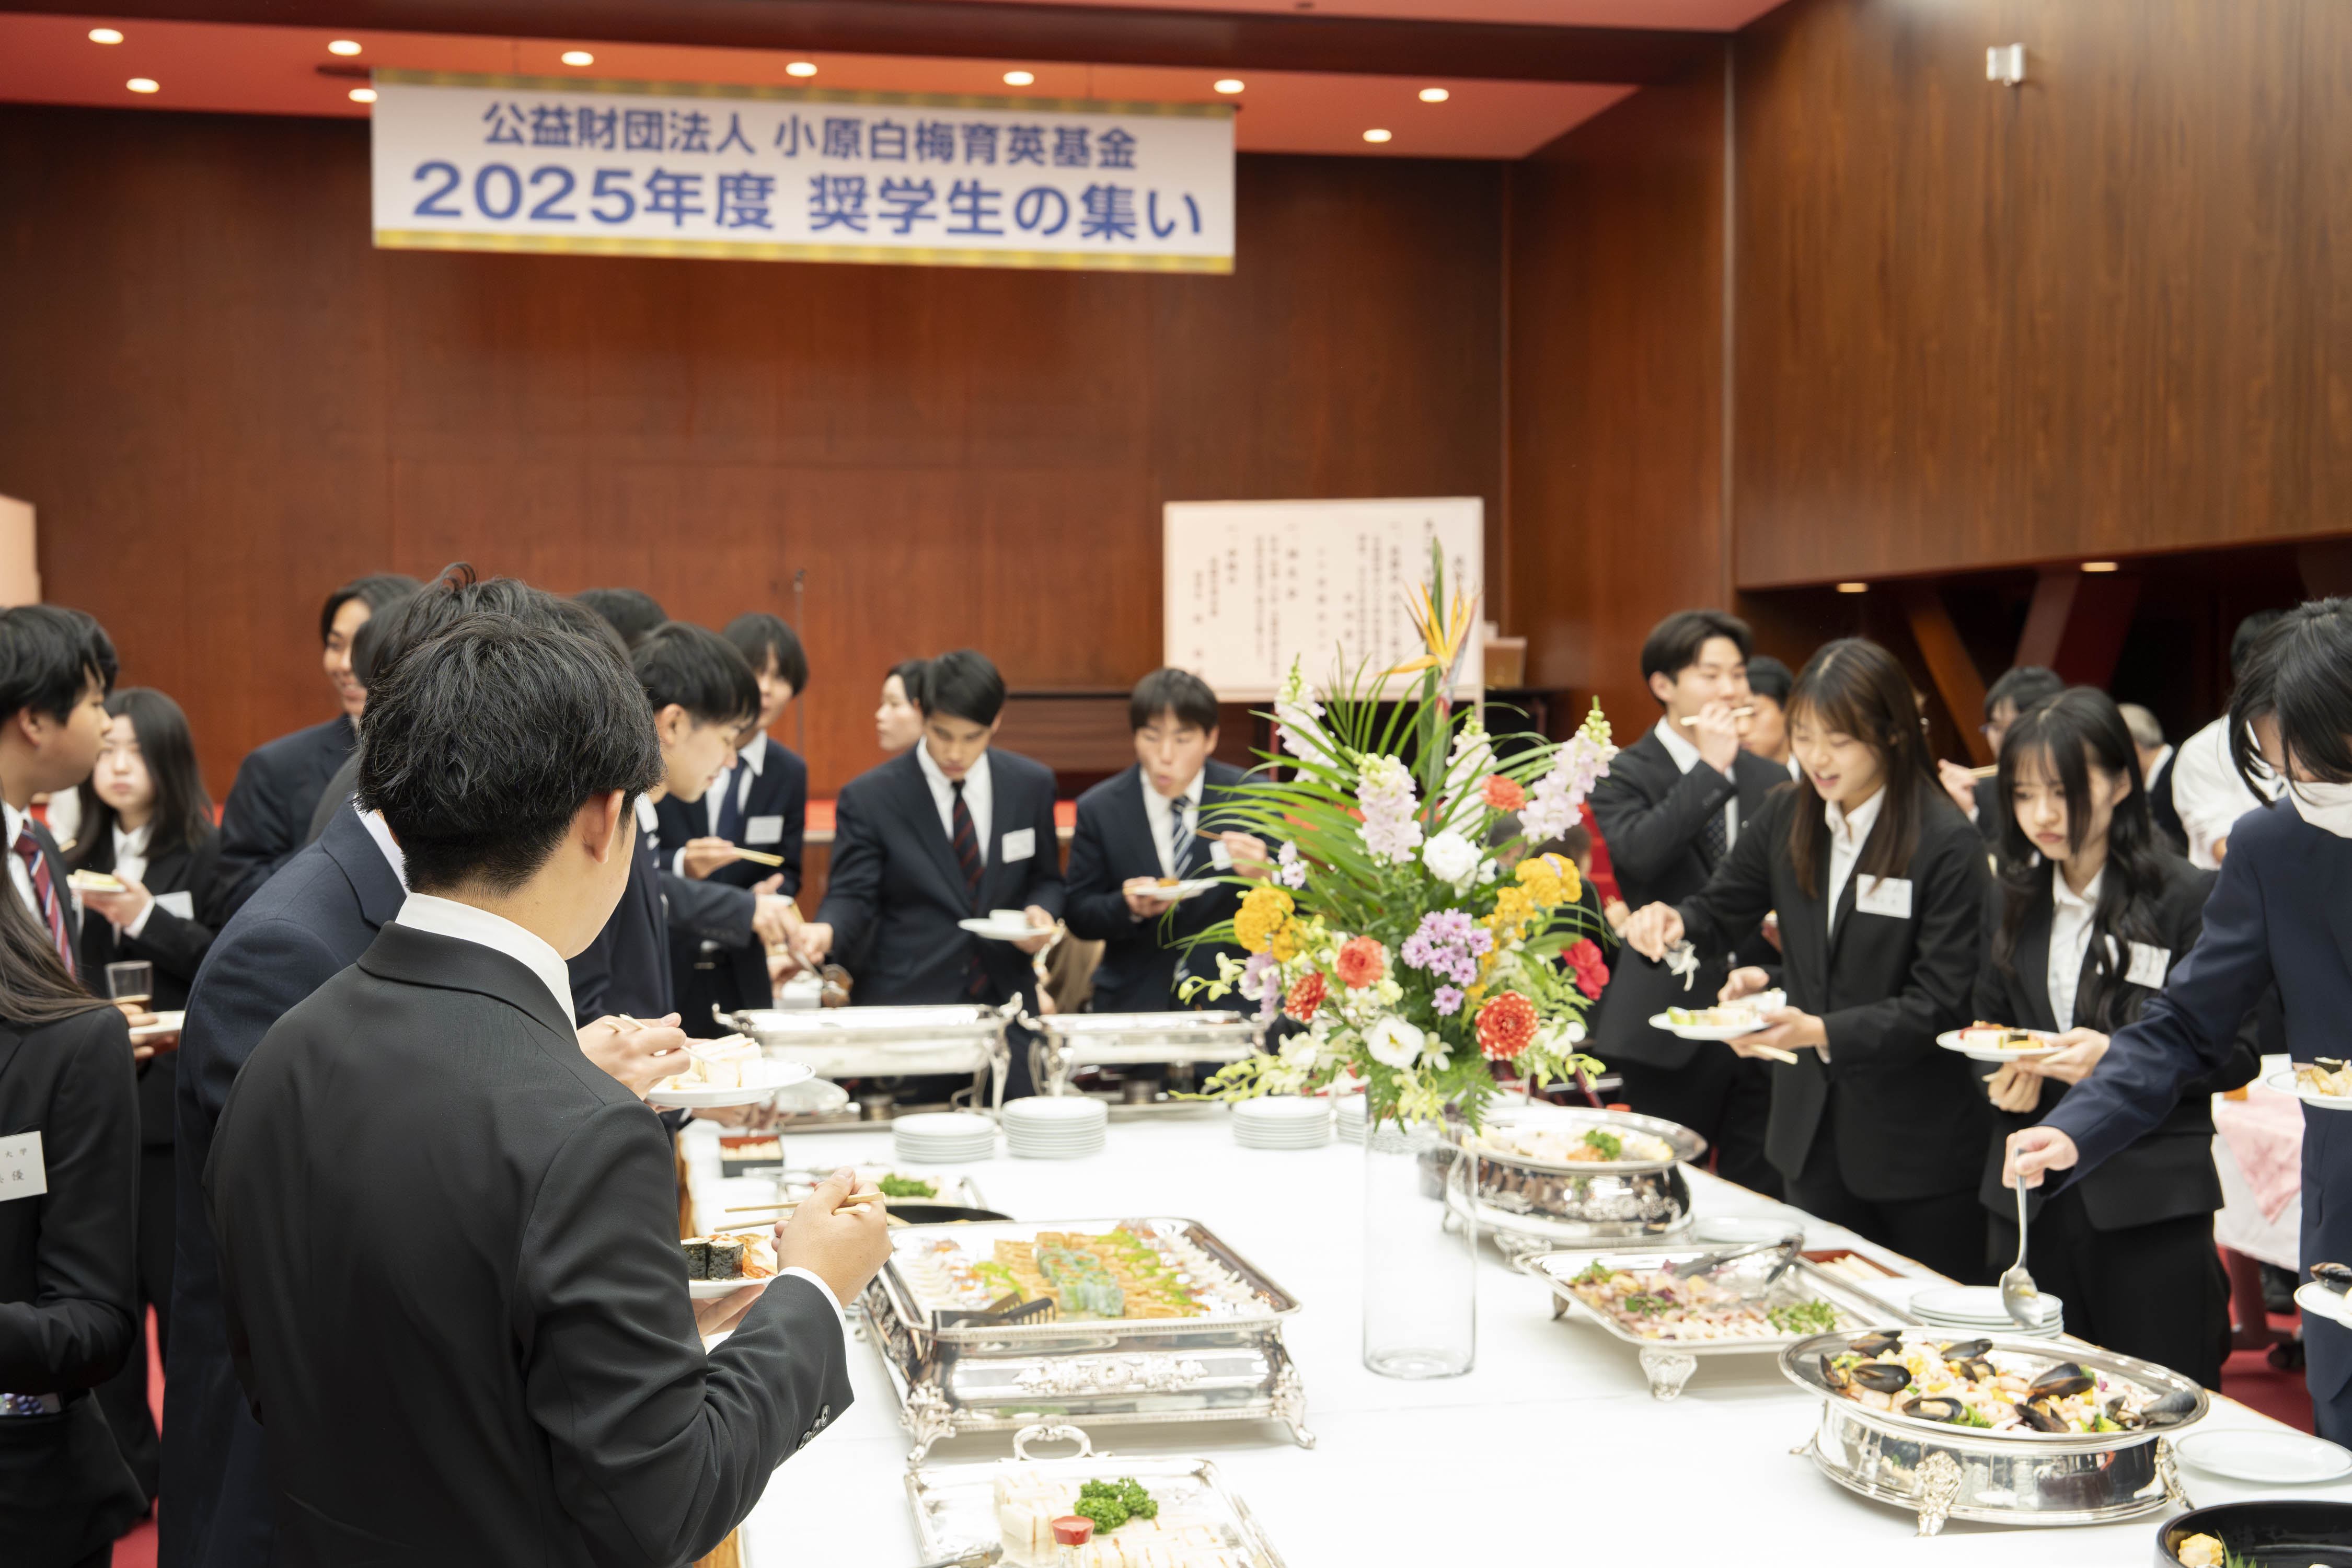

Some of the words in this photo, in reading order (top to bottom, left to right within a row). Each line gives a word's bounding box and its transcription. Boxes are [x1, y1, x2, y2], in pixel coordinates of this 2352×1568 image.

[483, 103, 756, 156] 公益財団法人
[775, 116, 1137, 170] 小原白梅育英基金
[412, 160, 776, 232] 2025年度
[806, 173, 1202, 243] 奨学生の集い
